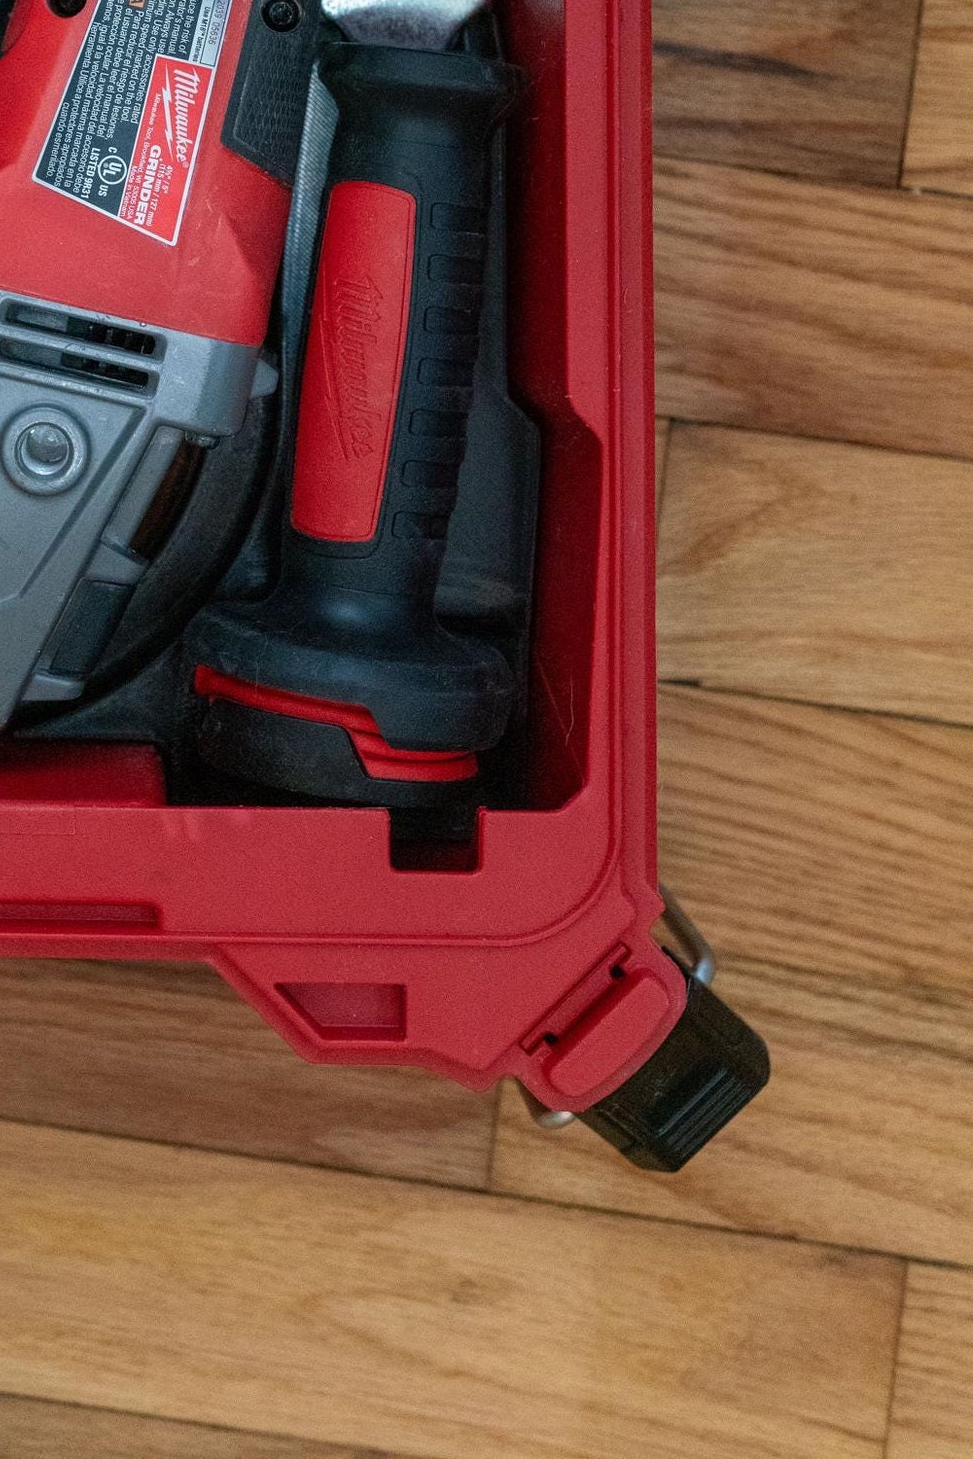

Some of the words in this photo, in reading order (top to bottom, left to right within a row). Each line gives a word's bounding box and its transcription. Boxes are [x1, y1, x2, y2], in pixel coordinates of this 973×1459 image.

[124, 6, 134, 17] el
[131, 8, 144, 30] Para
[182, 14, 195, 29] the
[94, 23, 110, 45] igual
[105, 3, 125, 46] protección
[116, 15, 132, 47] usuario
[135, 21, 151, 49] speed
[150, 18, 162, 36] Use
[158, 9, 175, 39] Always
[95, 43, 103, 51] a
[124, 29, 139, 59] reducir
[144, 35, 158, 54] only
[156, 37, 167, 54] use
[166, 23, 182, 56] manual.
[178, 28, 192, 46] risk
[93, 50, 104, 60] la
[100, 44, 115, 72] ocular.
[111, 46, 125, 68] debe
[176, 44, 188, 54] of
[122, 58, 132, 68] el
[129, 47, 145, 80] marked
[84, 59, 101, 99] velocidad
[97, 71, 109, 84] La
[107, 67, 120, 85] leer
[113, 66, 130, 93] riesgo
[126, 79, 136, 91] on
[134, 53, 154, 103] accessories
[105, 84, 116, 94] el
[113, 92, 124, 105] de
[123, 90, 135, 106] the
[88, 82, 106, 121] velocidad
[98, 92, 114, 124] manual
[147, 92, 161, 126] Milwaukee
[55, 101, 71, 132] cuando
[61, 98, 82, 144] protectores
[76, 97, 93, 132] máxima
[103, 104, 121, 141] lesiones,
[119, 105, 132, 124] tool.
[129, 101, 143, 125] rated
[86, 120, 97, 135] del
[95, 123, 106, 138] del
[142, 126, 153, 141] Tool,
[44, 131, 64, 179] esmerilado.
[67, 131, 85, 168] marcada
[76, 133, 94, 173] accesorio
[135, 140, 150, 174] Brookfield,
[51, 142, 71, 188] apropiados
[85, 146, 100, 177] LISTED
[156, 162, 166, 178] (115
[62, 178, 73, 188] la
[65, 167, 74, 179] en
[71, 172, 85, 194] debe
[127, 165, 138, 184] Made
[79, 176, 93, 199] 9R31
[97, 183, 108, 197] US
[125, 183, 133, 191] in
[128, 184, 139, 205] 53005
[132, 143, 162, 226] GRINDER
[152, 178, 162, 192] mm
[119, 190, 132, 218] Vietnam
[124, 204, 135, 220] USA
[148, 196, 158, 210] 127
[144, 210, 155, 227] mm)
